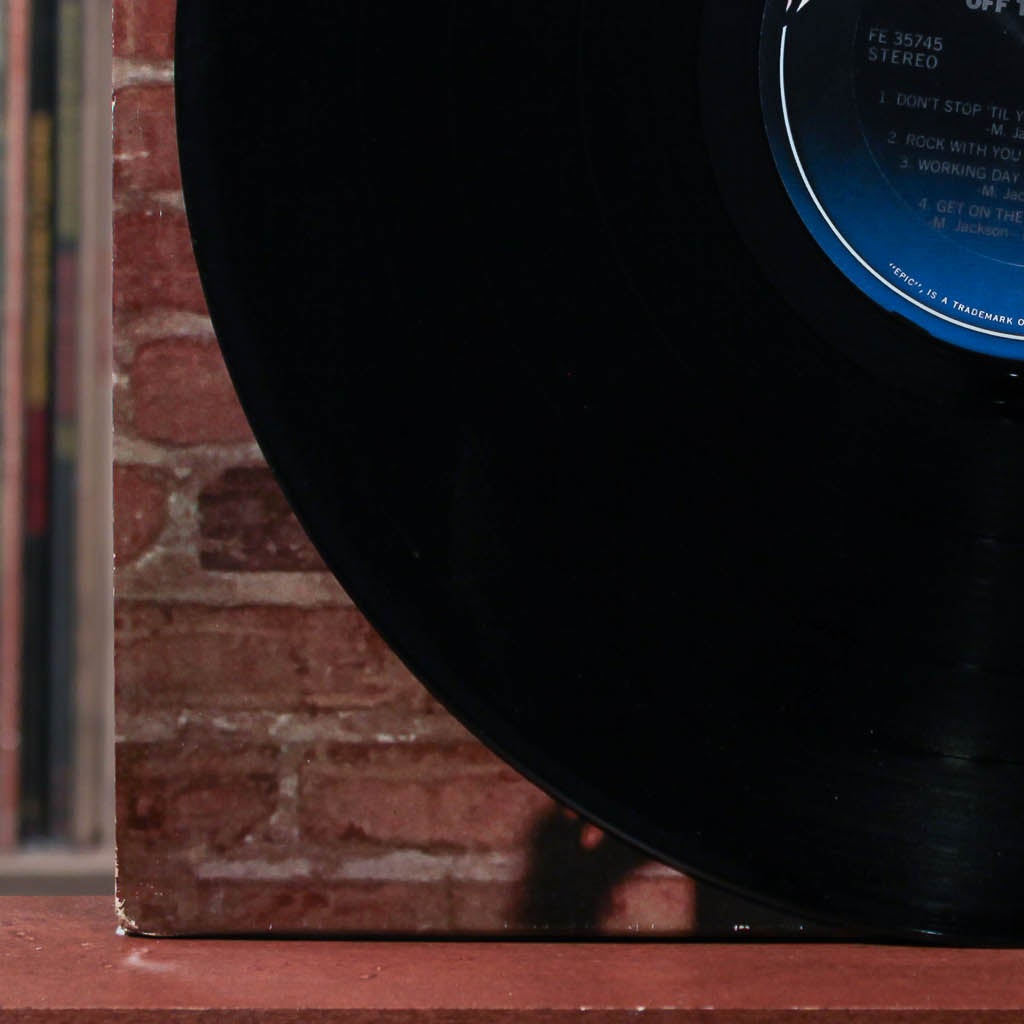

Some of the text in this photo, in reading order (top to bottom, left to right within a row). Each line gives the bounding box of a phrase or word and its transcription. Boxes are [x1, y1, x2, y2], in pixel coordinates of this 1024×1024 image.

[868, 27, 944, 52] FE 35745
[868, 46, 939, 70] STEREO
[896, 93, 939, 111] DON'T
[944, 99, 982, 117] STOP
[986, 105, 1010, 121] 'TIL
[906, 133, 945, 150] ROCK
[950, 140, 987, 157] WITH
[992, 145, 1021, 162] YOU
[918, 159, 986, 180] WORKING
[992, 168, 1019, 184] DAY
[936, 199, 965, 215] GET
[969, 204, 991, 219] ON
[996, 207, 1024, 224] THE
[926, 289, 938, 299] IS
[941, 296, 948, 305] A
[953, 301, 1013, 325] TRADEMARK
